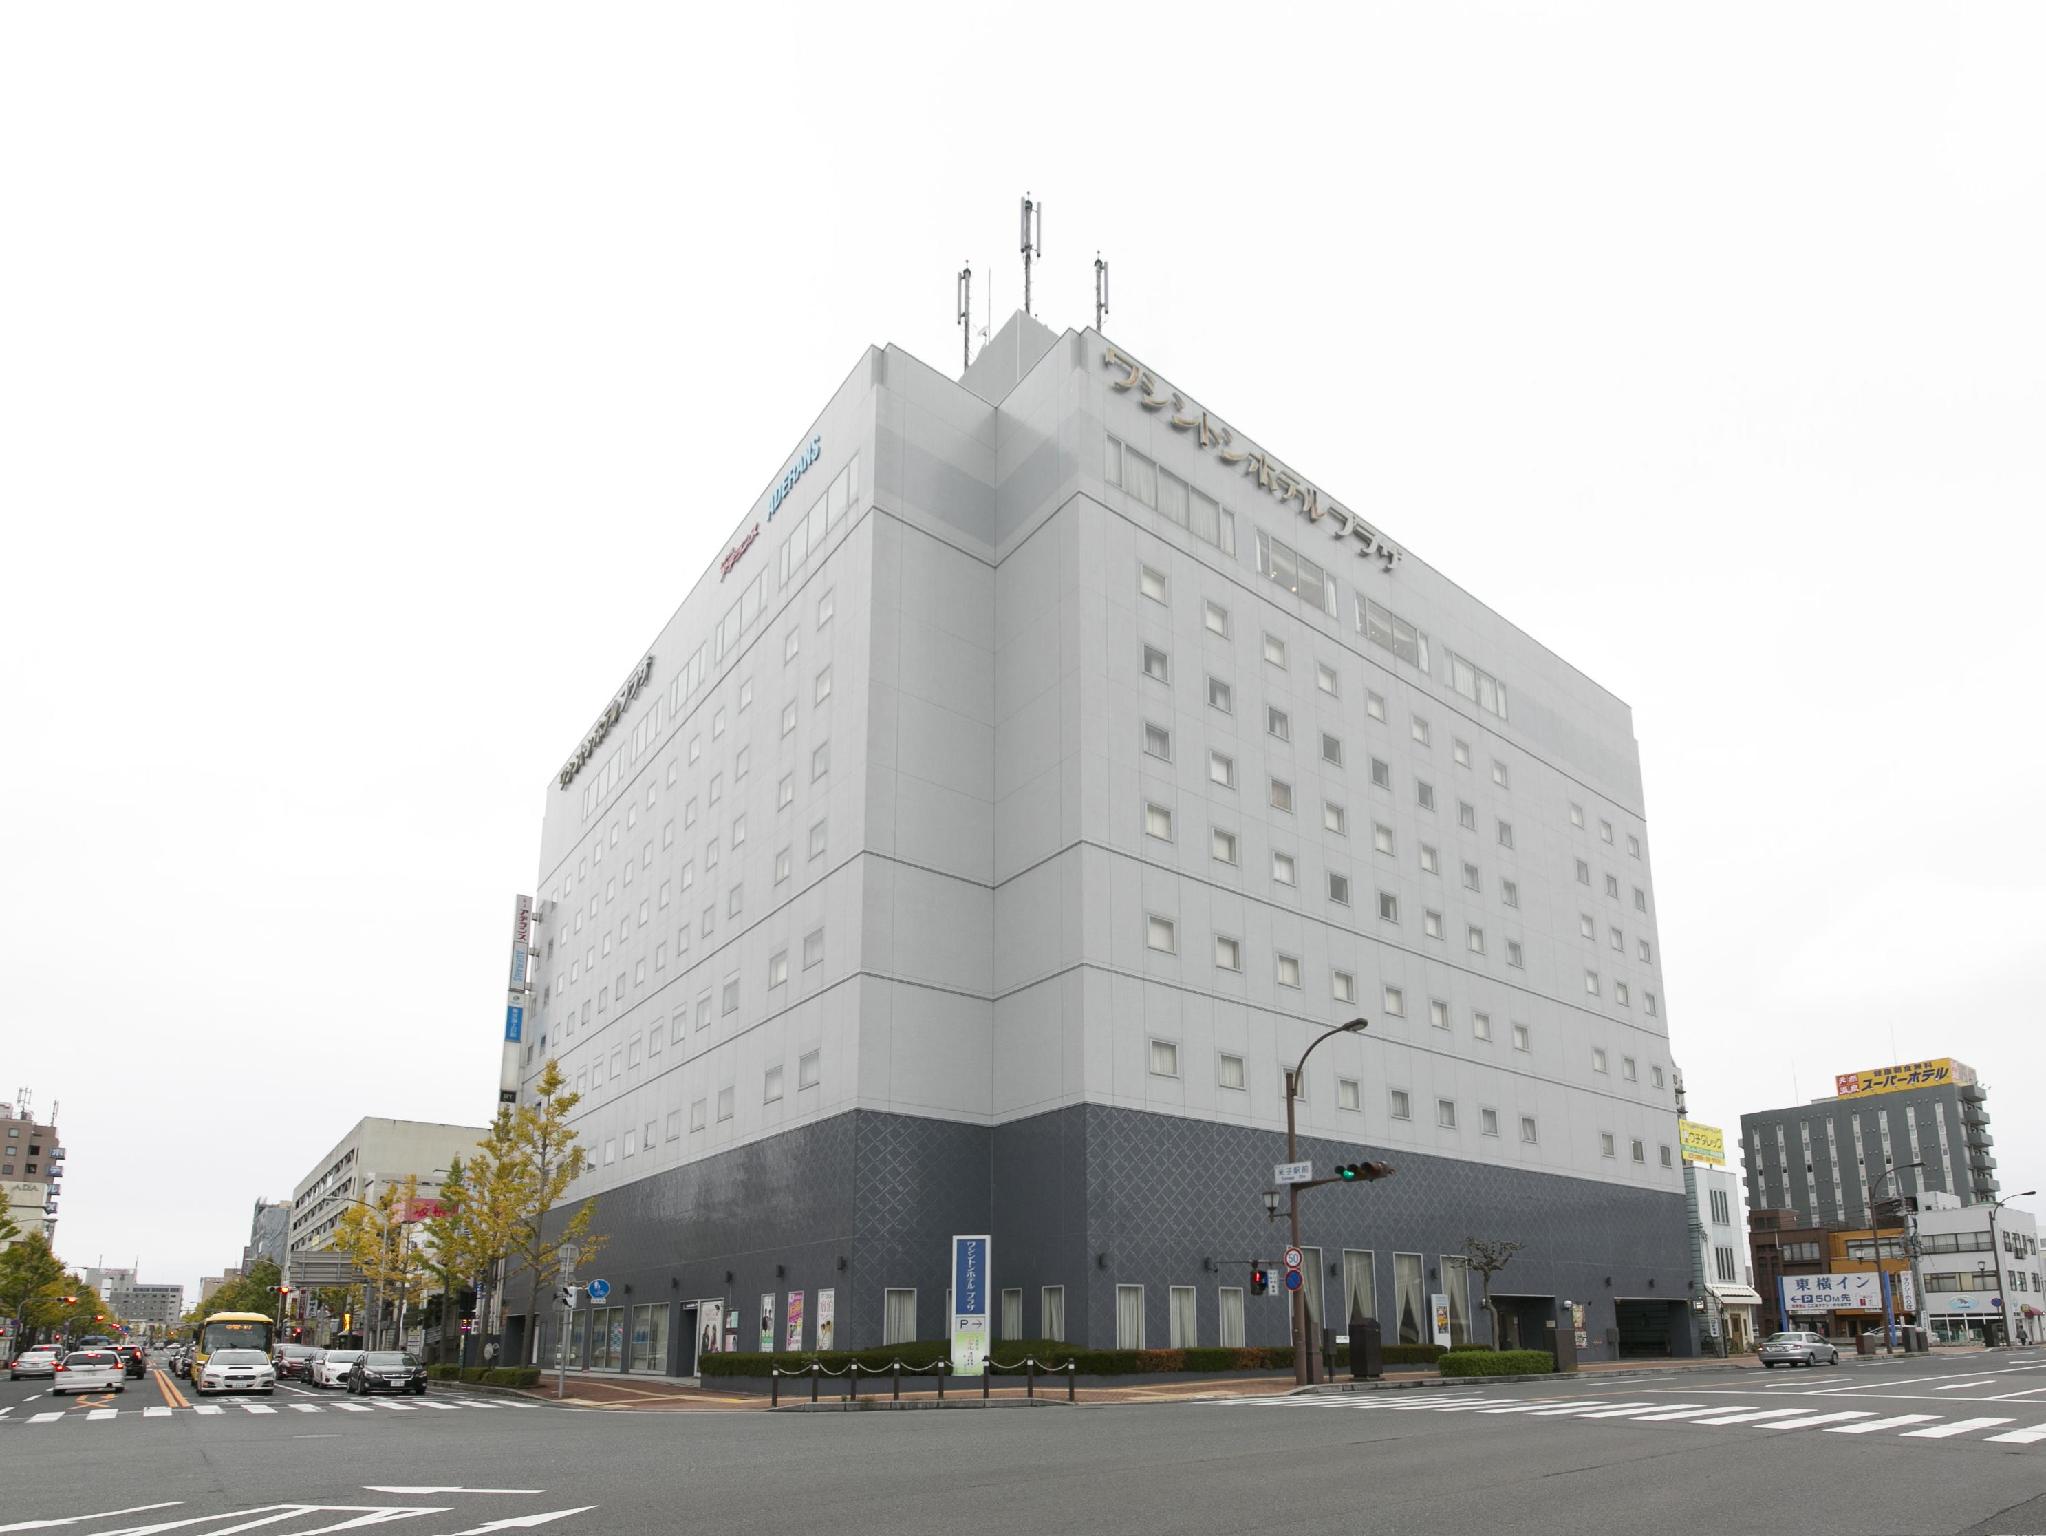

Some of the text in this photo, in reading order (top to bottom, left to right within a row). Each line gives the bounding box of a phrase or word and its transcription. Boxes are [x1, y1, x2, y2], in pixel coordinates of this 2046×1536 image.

[1104, 346, 1403, 571] ワシントンホテルプラザ
[766, 434, 821, 522] ADERANS
[1861, 1067, 1949, 1092] スーパーホテル
[1288, 1254, 1298, 1263] 50
[1795, 1276, 1870, 1291] 東横イン
[960, 1319, 968, 1329] P
